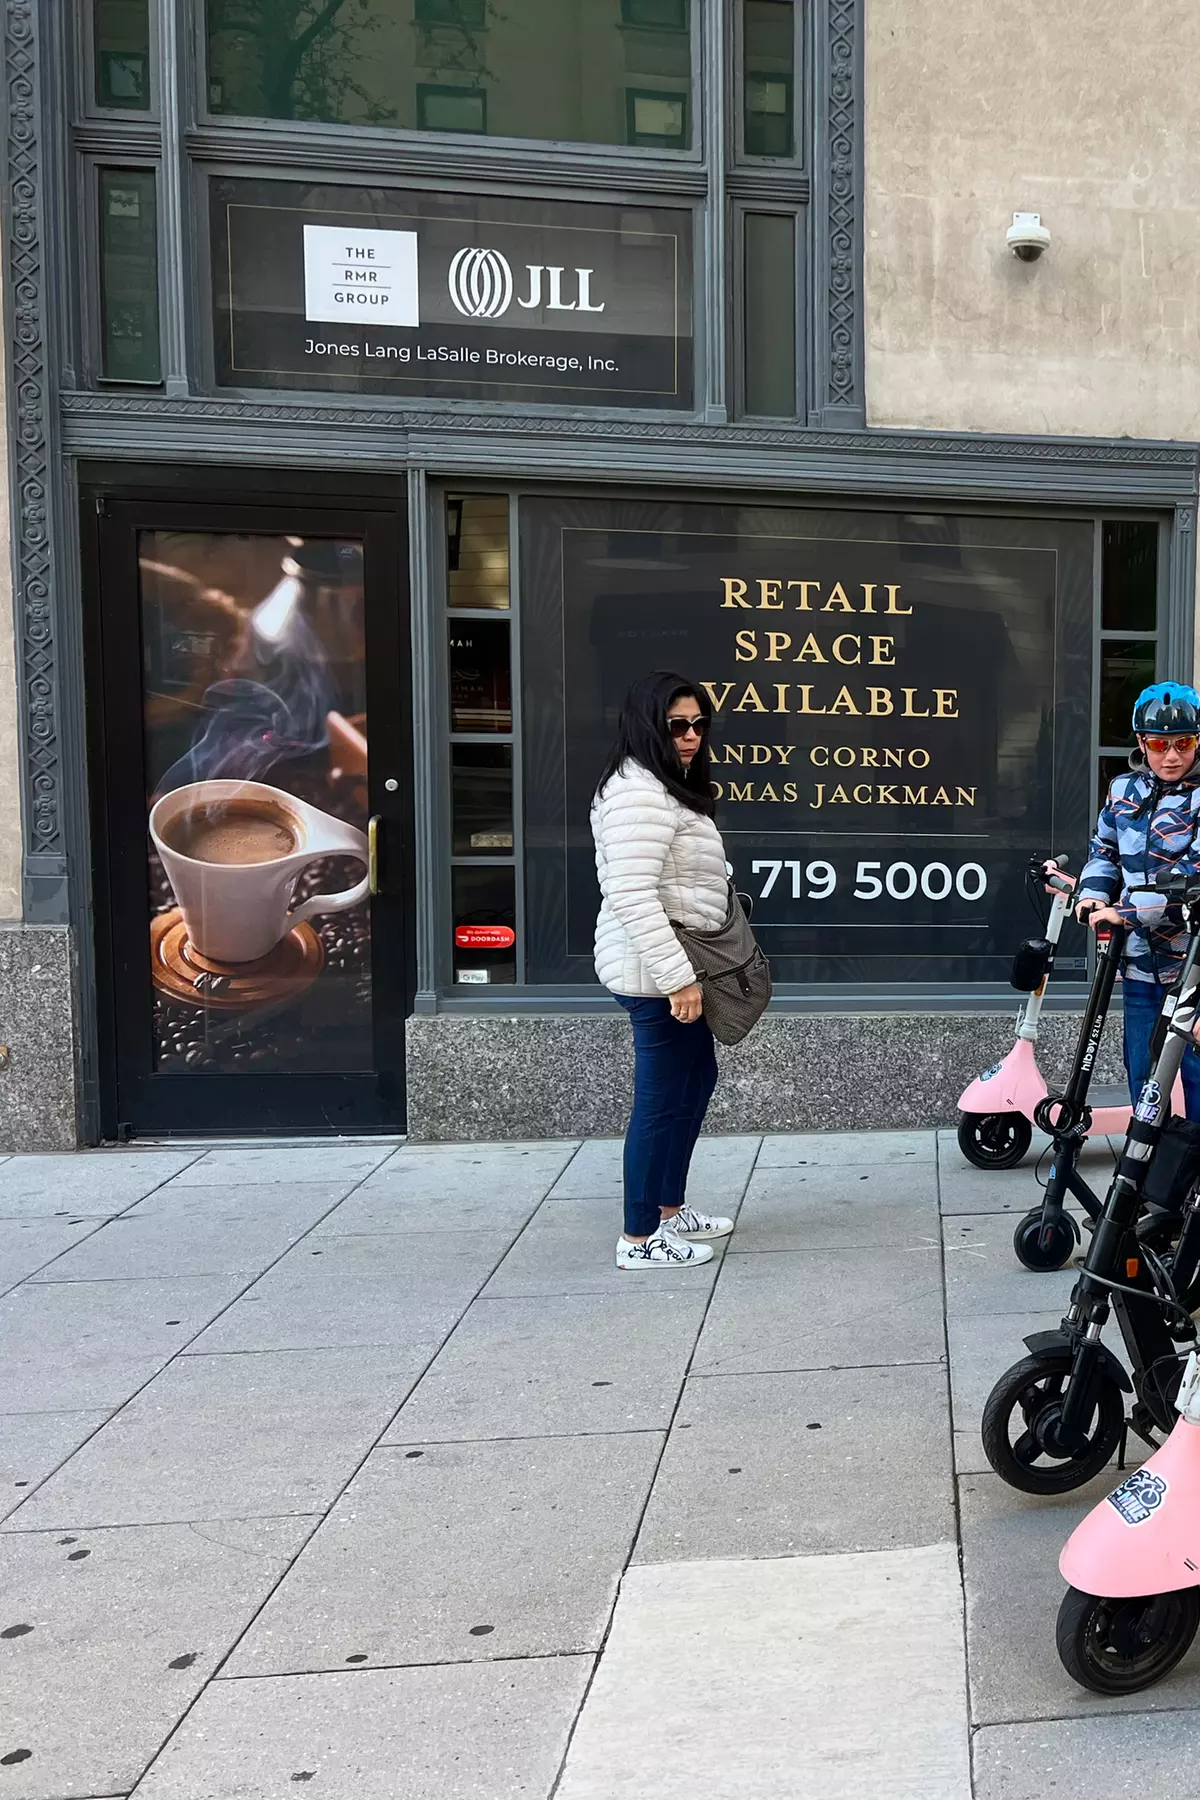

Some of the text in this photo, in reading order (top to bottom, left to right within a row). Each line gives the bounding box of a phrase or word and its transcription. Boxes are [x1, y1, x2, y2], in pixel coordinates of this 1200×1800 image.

[345, 247, 376, 260] THE
[344, 270, 378, 282] RMR
[516, 264, 606, 313] JLL
[333, 292, 390, 306] GROUP
[304, 339, 619, 372] Jones Lang LaSalle Brokerage, Inc.
[719, 577, 913, 615] RETAIL
[735, 630, 896, 666] SPACE
[699, 681, 960, 719] VAILABLE
[809, 746, 931, 769] CORNO
[709, 781, 978, 809] OMAS JACKMAN
[751, 860, 988, 901] 719 5000
